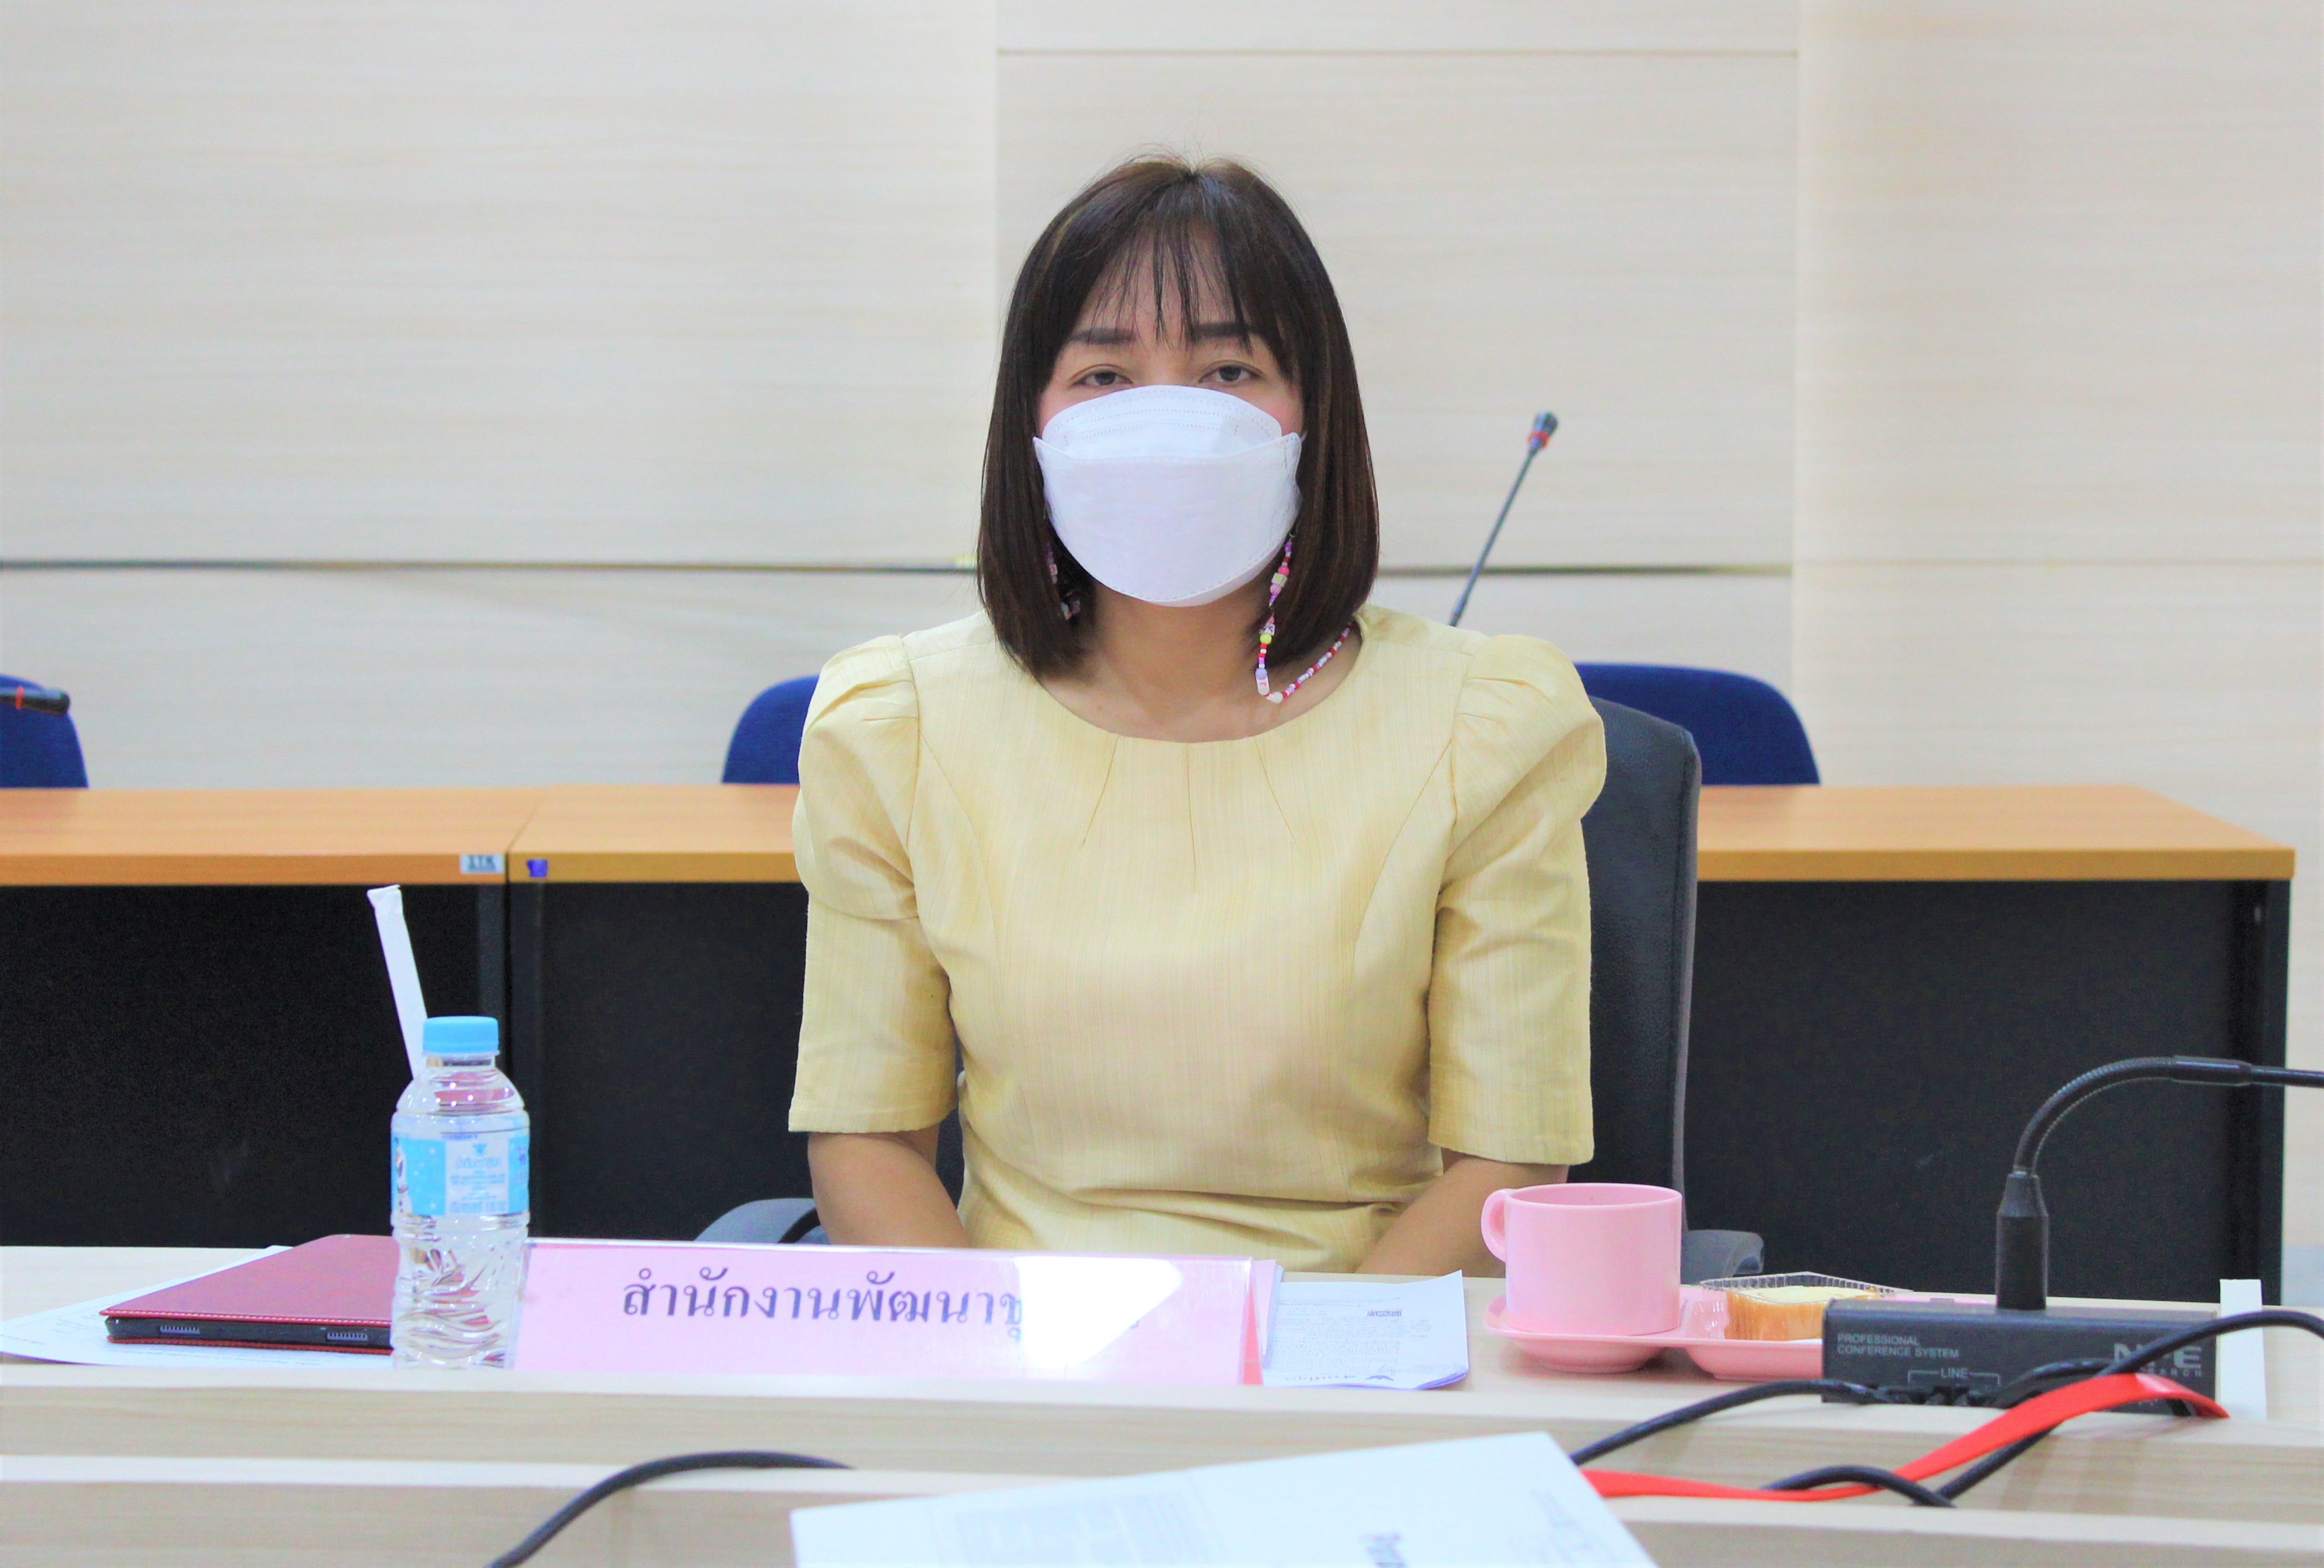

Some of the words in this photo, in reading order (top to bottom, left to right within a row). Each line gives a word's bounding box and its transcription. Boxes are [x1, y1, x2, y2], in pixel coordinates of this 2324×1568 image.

[623, 1266, 1140, 1343] สำนักงานพัฒนาชุ
[1837, 1333, 1920, 1346] PROFESSIONAL
[1837, 1345, 1911, 1358] CONFERENCE
[1914, 1347, 1960, 1359] SYSTEM
[2114, 1343, 2202, 1369] NE
[1941, 1368, 1969, 1379] LINE
